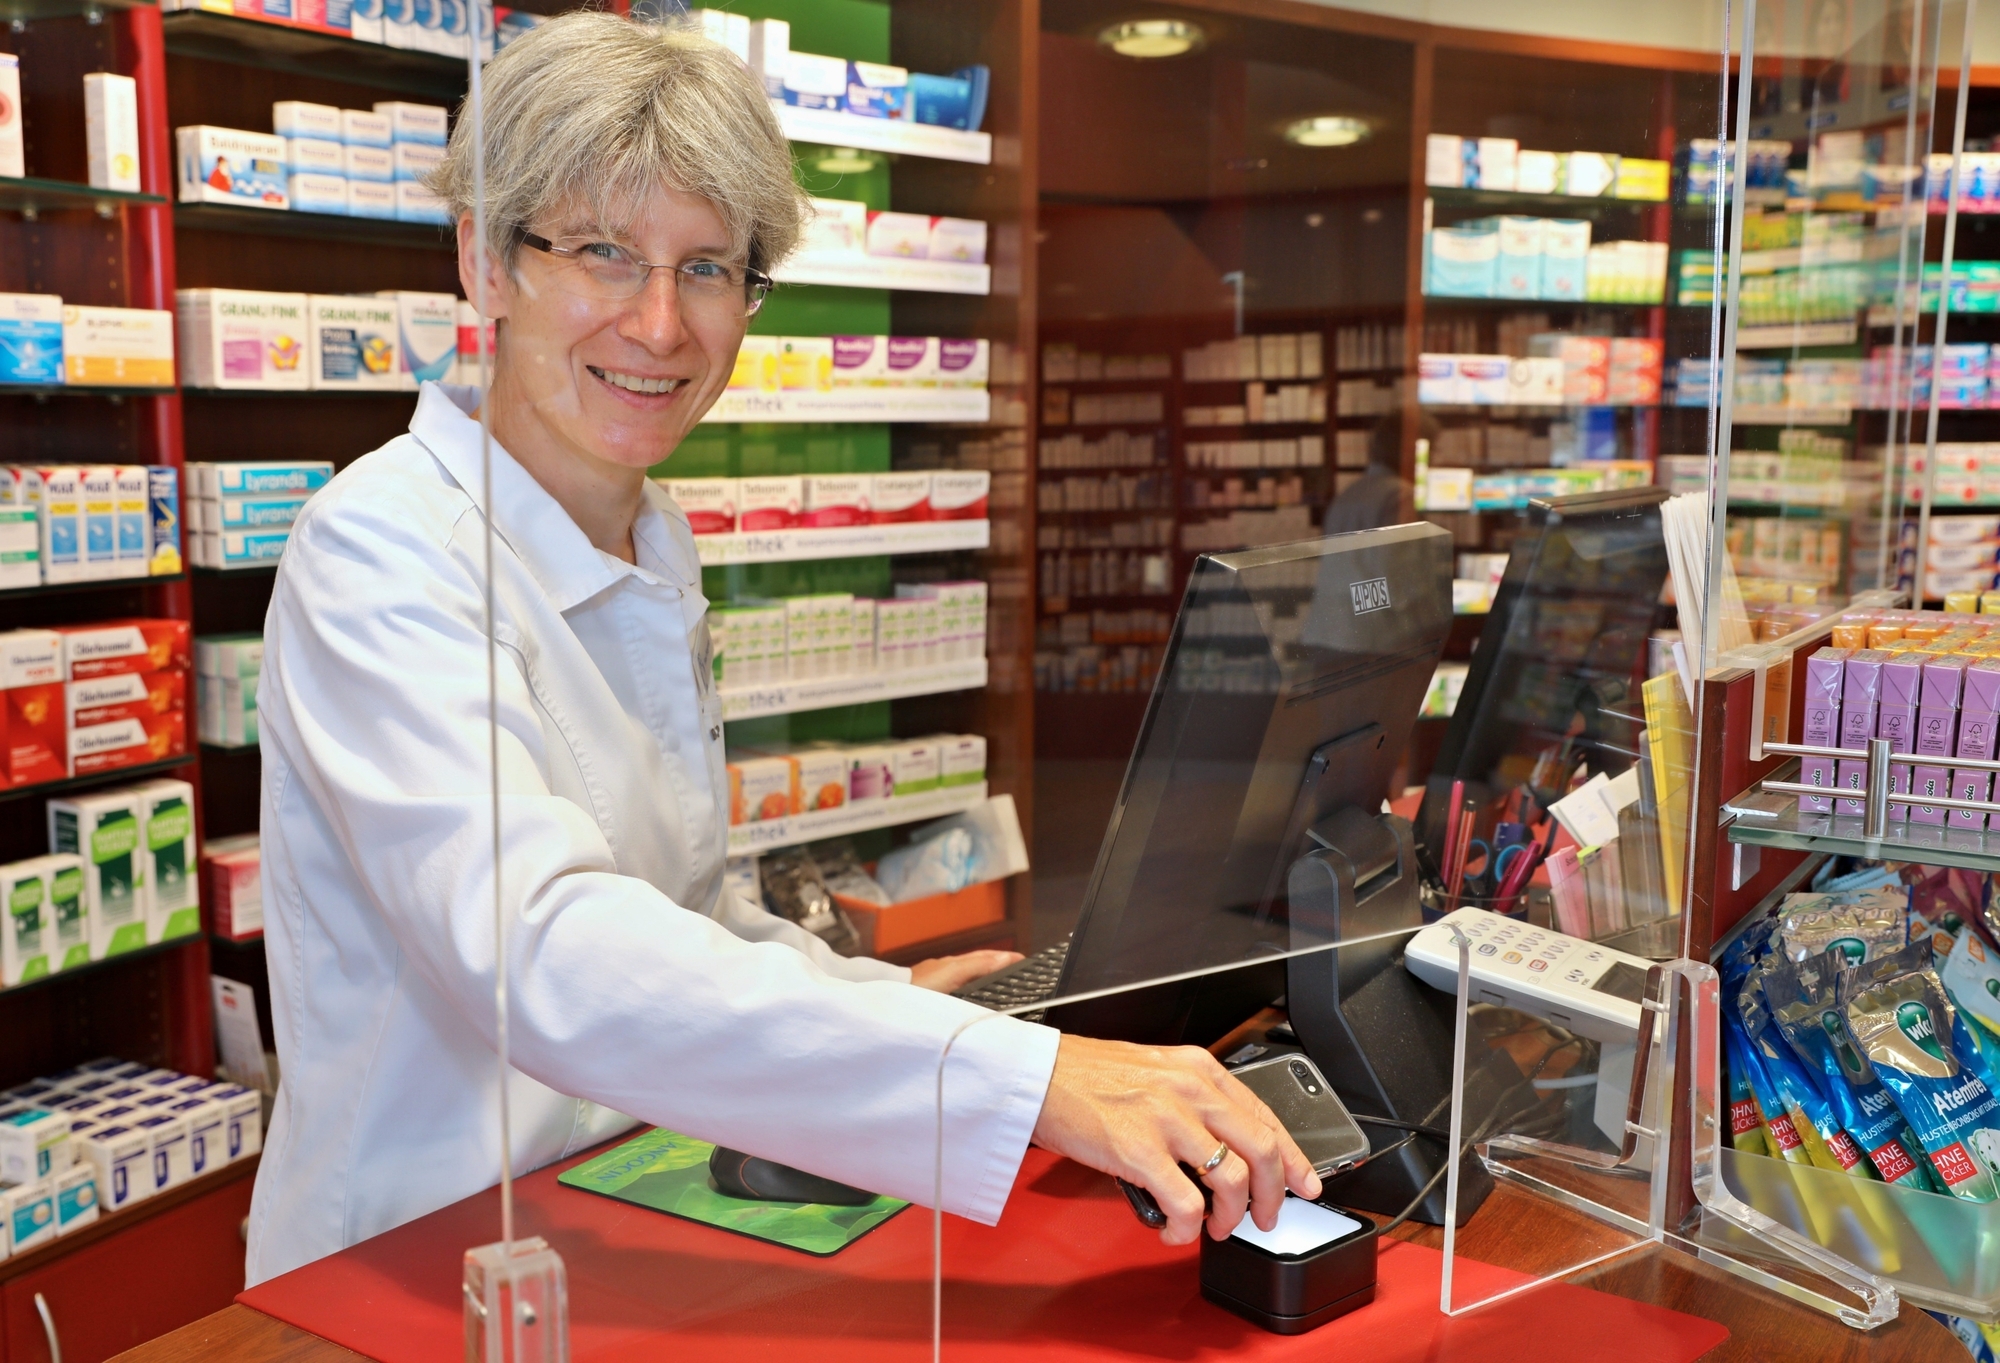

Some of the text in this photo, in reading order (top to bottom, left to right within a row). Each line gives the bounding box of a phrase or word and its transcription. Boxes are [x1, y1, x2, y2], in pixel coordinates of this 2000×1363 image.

[674, 485, 723, 498] Tebonin
[744, 483, 788, 496] Tebonin
[816, 480, 860, 493] Tebonin
[247, 504, 301, 527] Lyrand
[248, 538, 287, 560] Lyra
[1353, 579, 1389, 612] 4POS
[1932, 1075, 1988, 1117] Atemfrei
[1828, 1134, 1851, 1156] HNE
[596, 1141, 677, 1183] ANGOCIN
[1871, 1144, 1903, 1169] HNE
[1934, 1147, 1965, 1169] HNE
[1942, 1161, 1972, 1182] CKER
